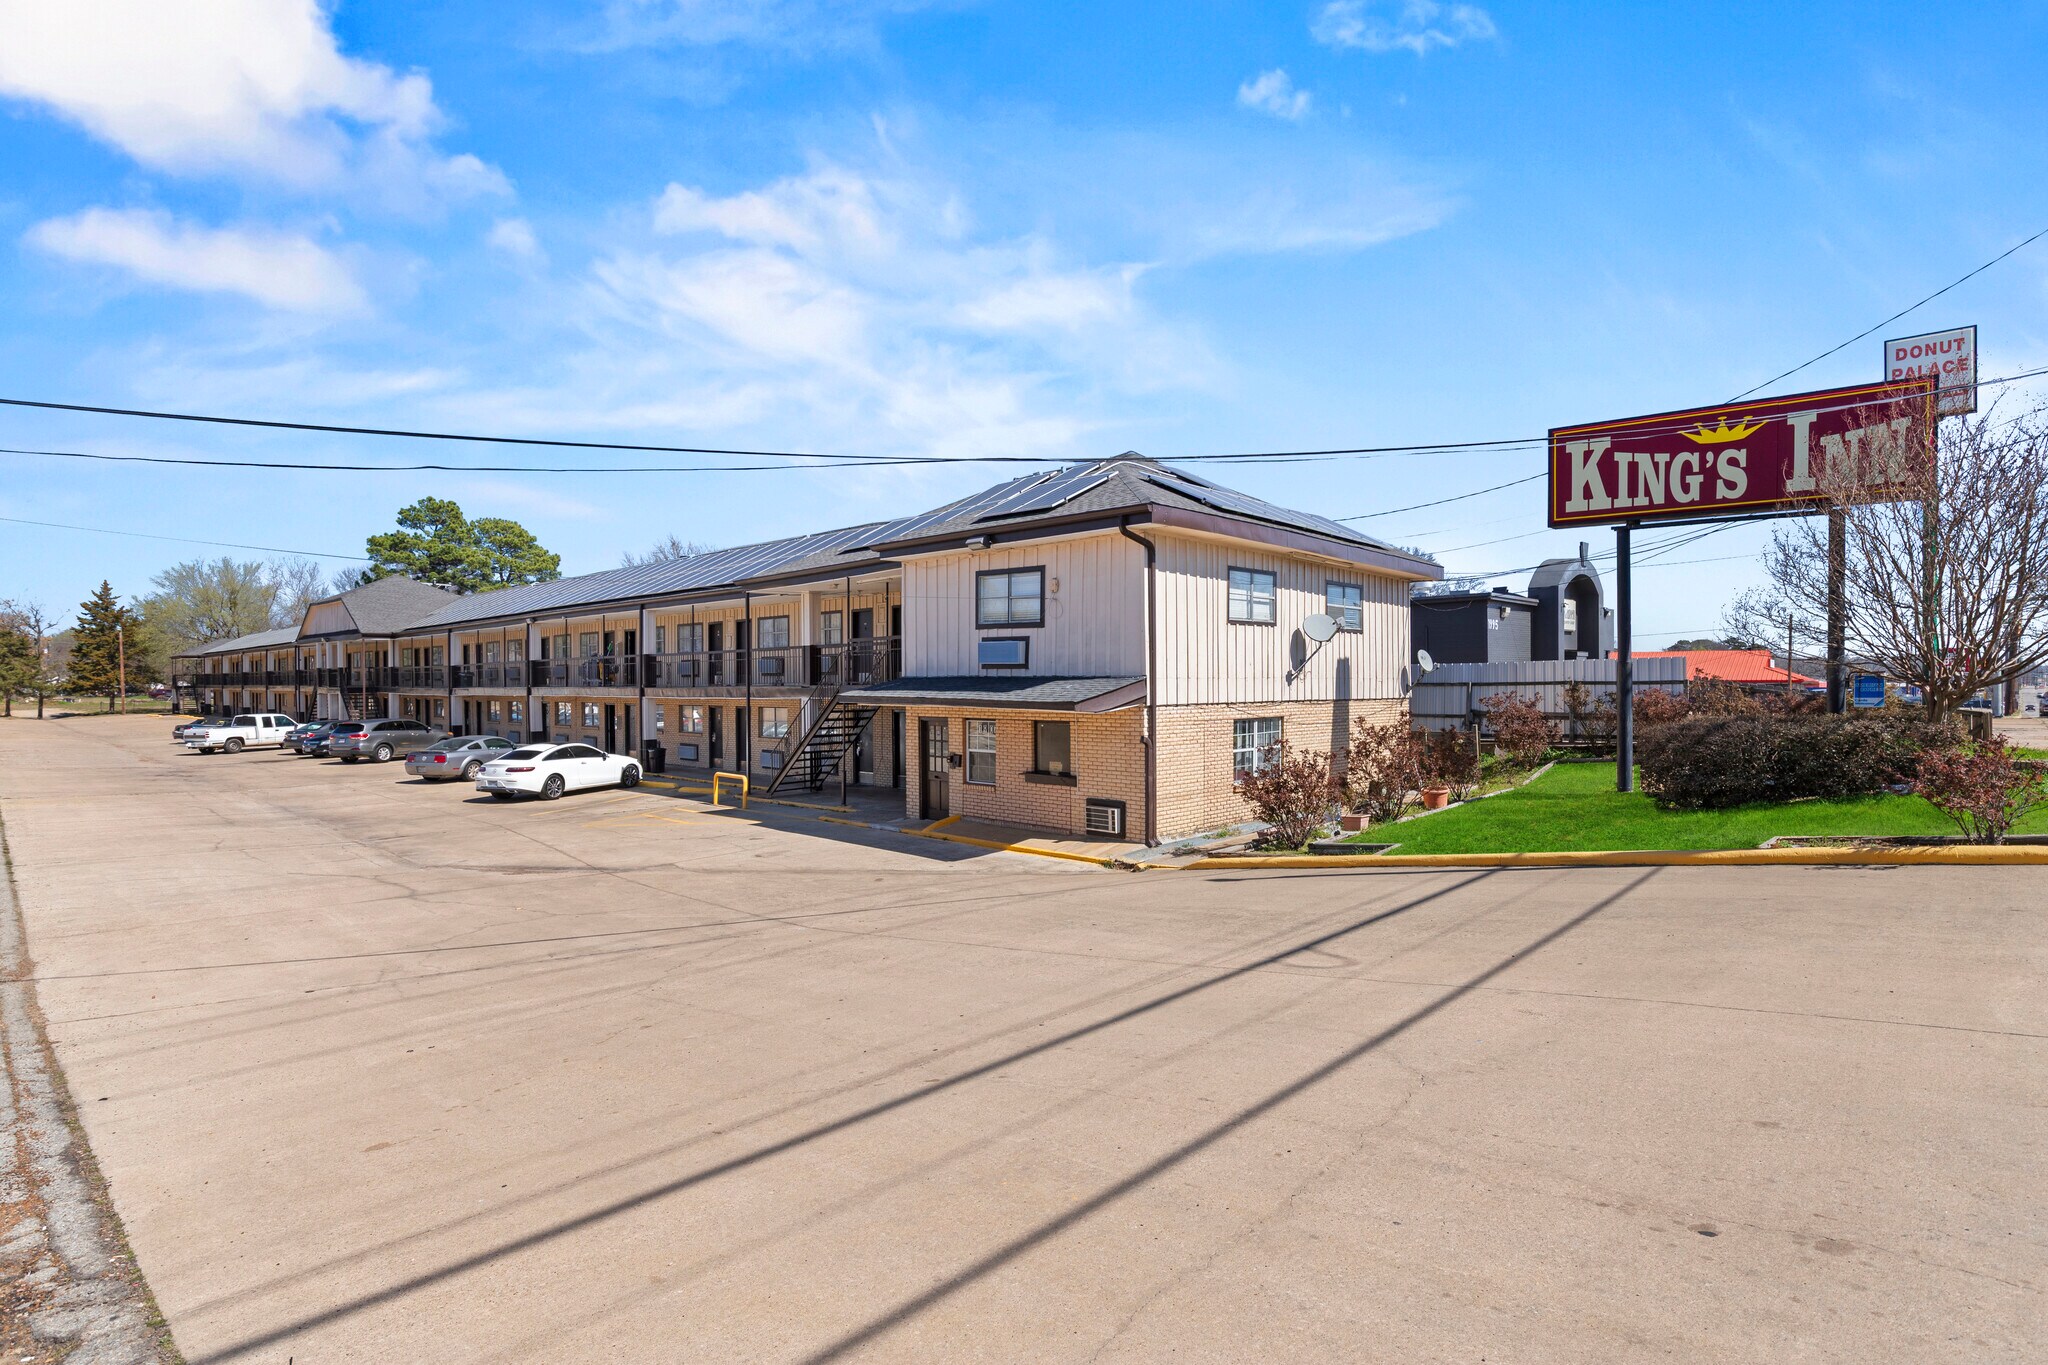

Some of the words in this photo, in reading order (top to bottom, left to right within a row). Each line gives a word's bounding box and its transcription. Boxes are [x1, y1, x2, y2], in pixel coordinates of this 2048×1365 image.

[1895, 337, 1965, 361] DONUT
[1565, 436, 1748, 513] KING'S
[1785, 409, 1912, 490] INN
